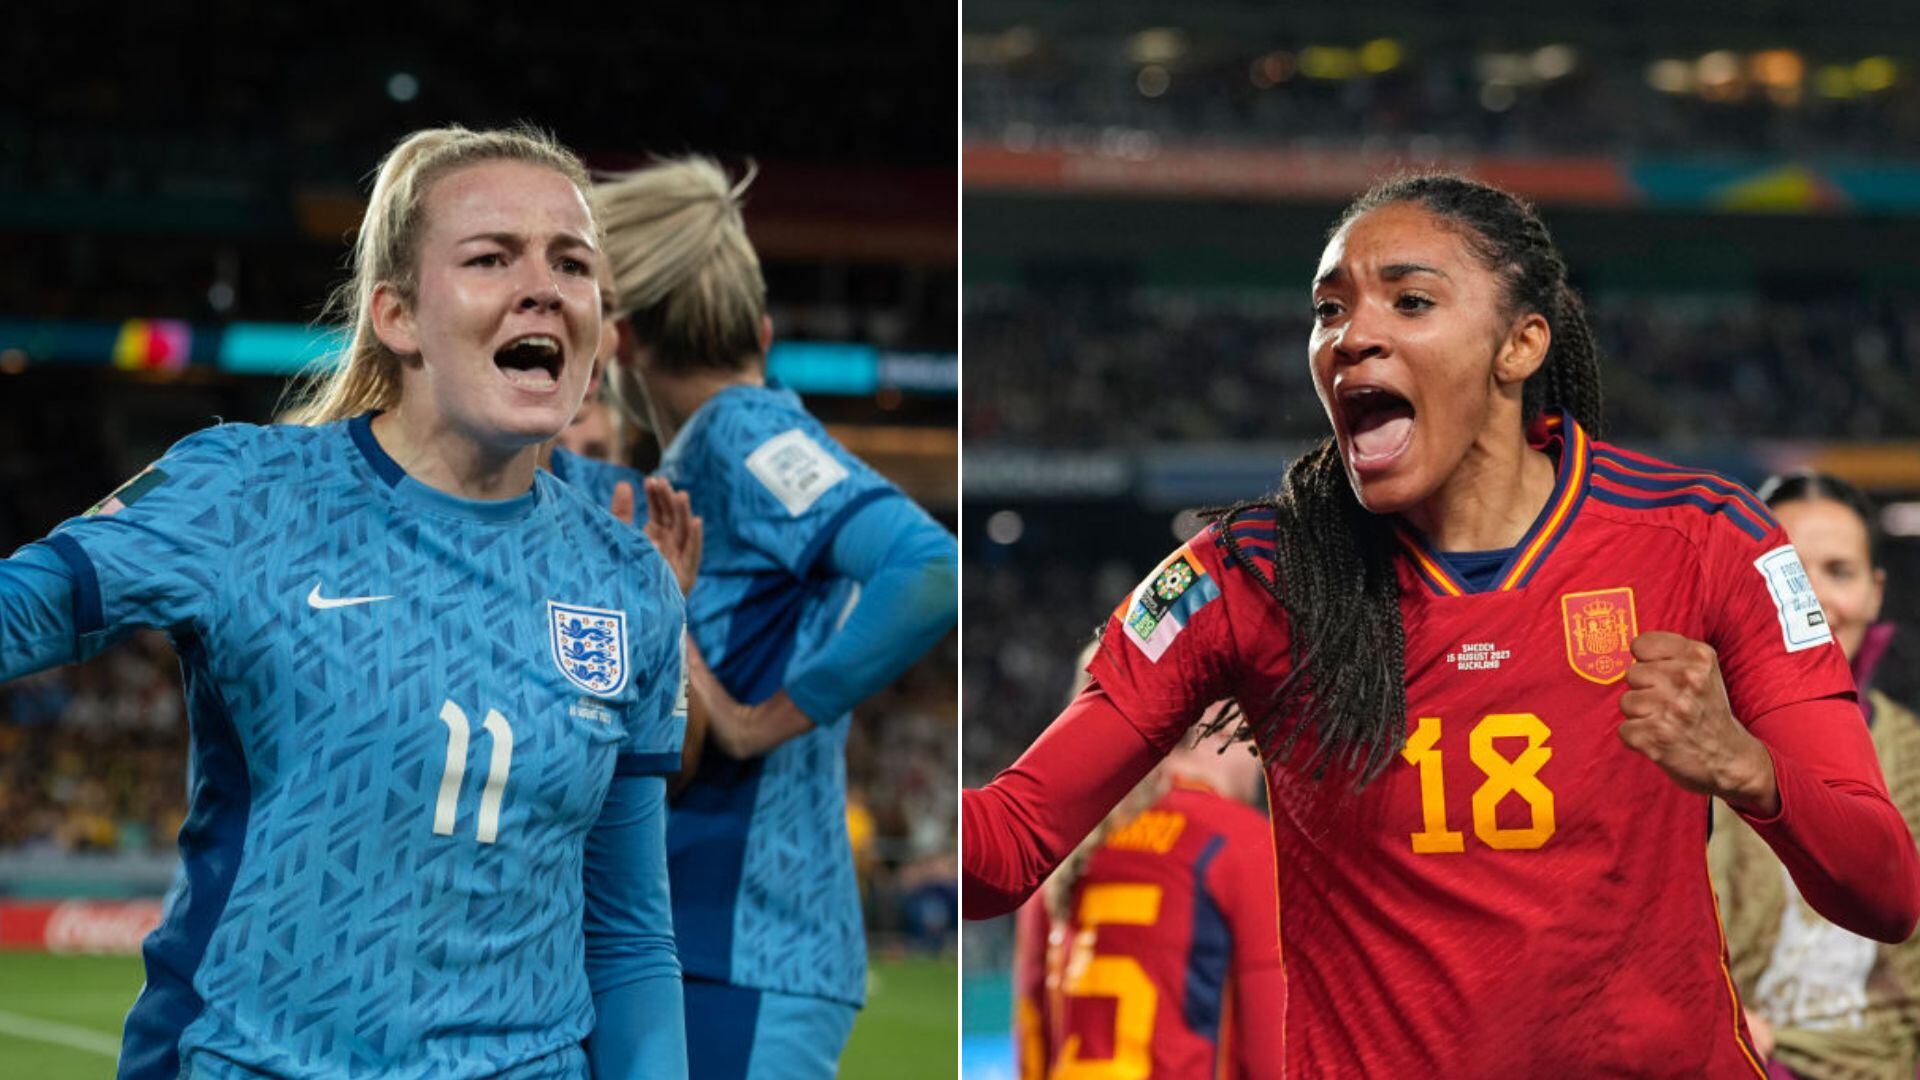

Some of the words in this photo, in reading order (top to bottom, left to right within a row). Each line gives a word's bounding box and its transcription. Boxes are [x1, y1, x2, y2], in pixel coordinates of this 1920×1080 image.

[1457, 652, 1488, 661] AUGUST
[433, 699, 513, 843] 11
[1401, 713, 1556, 853] 18
